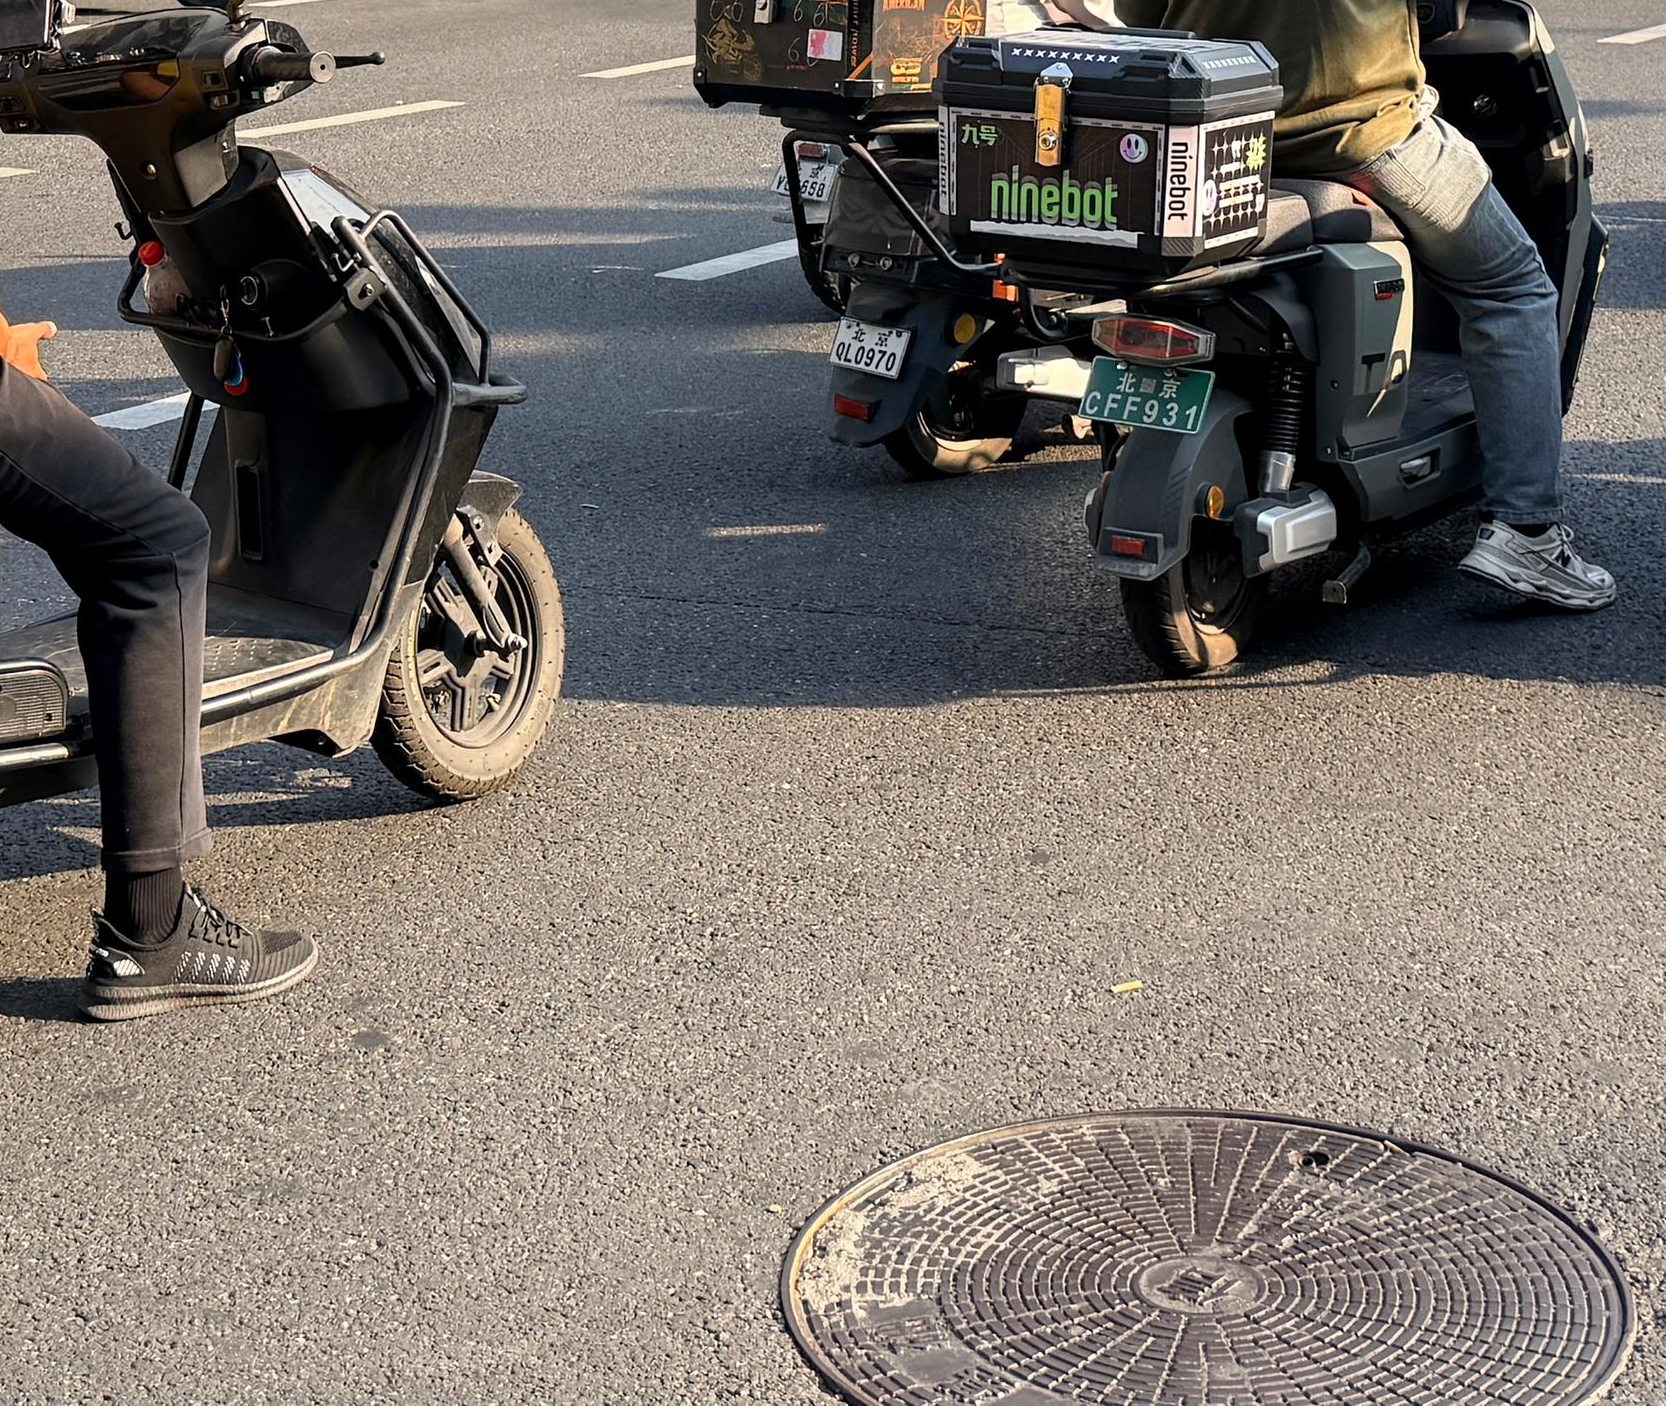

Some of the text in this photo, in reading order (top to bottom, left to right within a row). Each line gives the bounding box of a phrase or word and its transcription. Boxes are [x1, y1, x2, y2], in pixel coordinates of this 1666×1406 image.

[960, 123, 1000, 147] 九号
[940, 122, 949, 198] ninebot
[990, 166, 1118, 230] ninebot
[1168, 141, 1192, 221] ninebot
[851, 328, 895, 347] 北京
[836, 341, 896, 373] QL0970
[1116, 372, 1181, 399] 北京
[1084, 390, 1198, 430] CFF931
